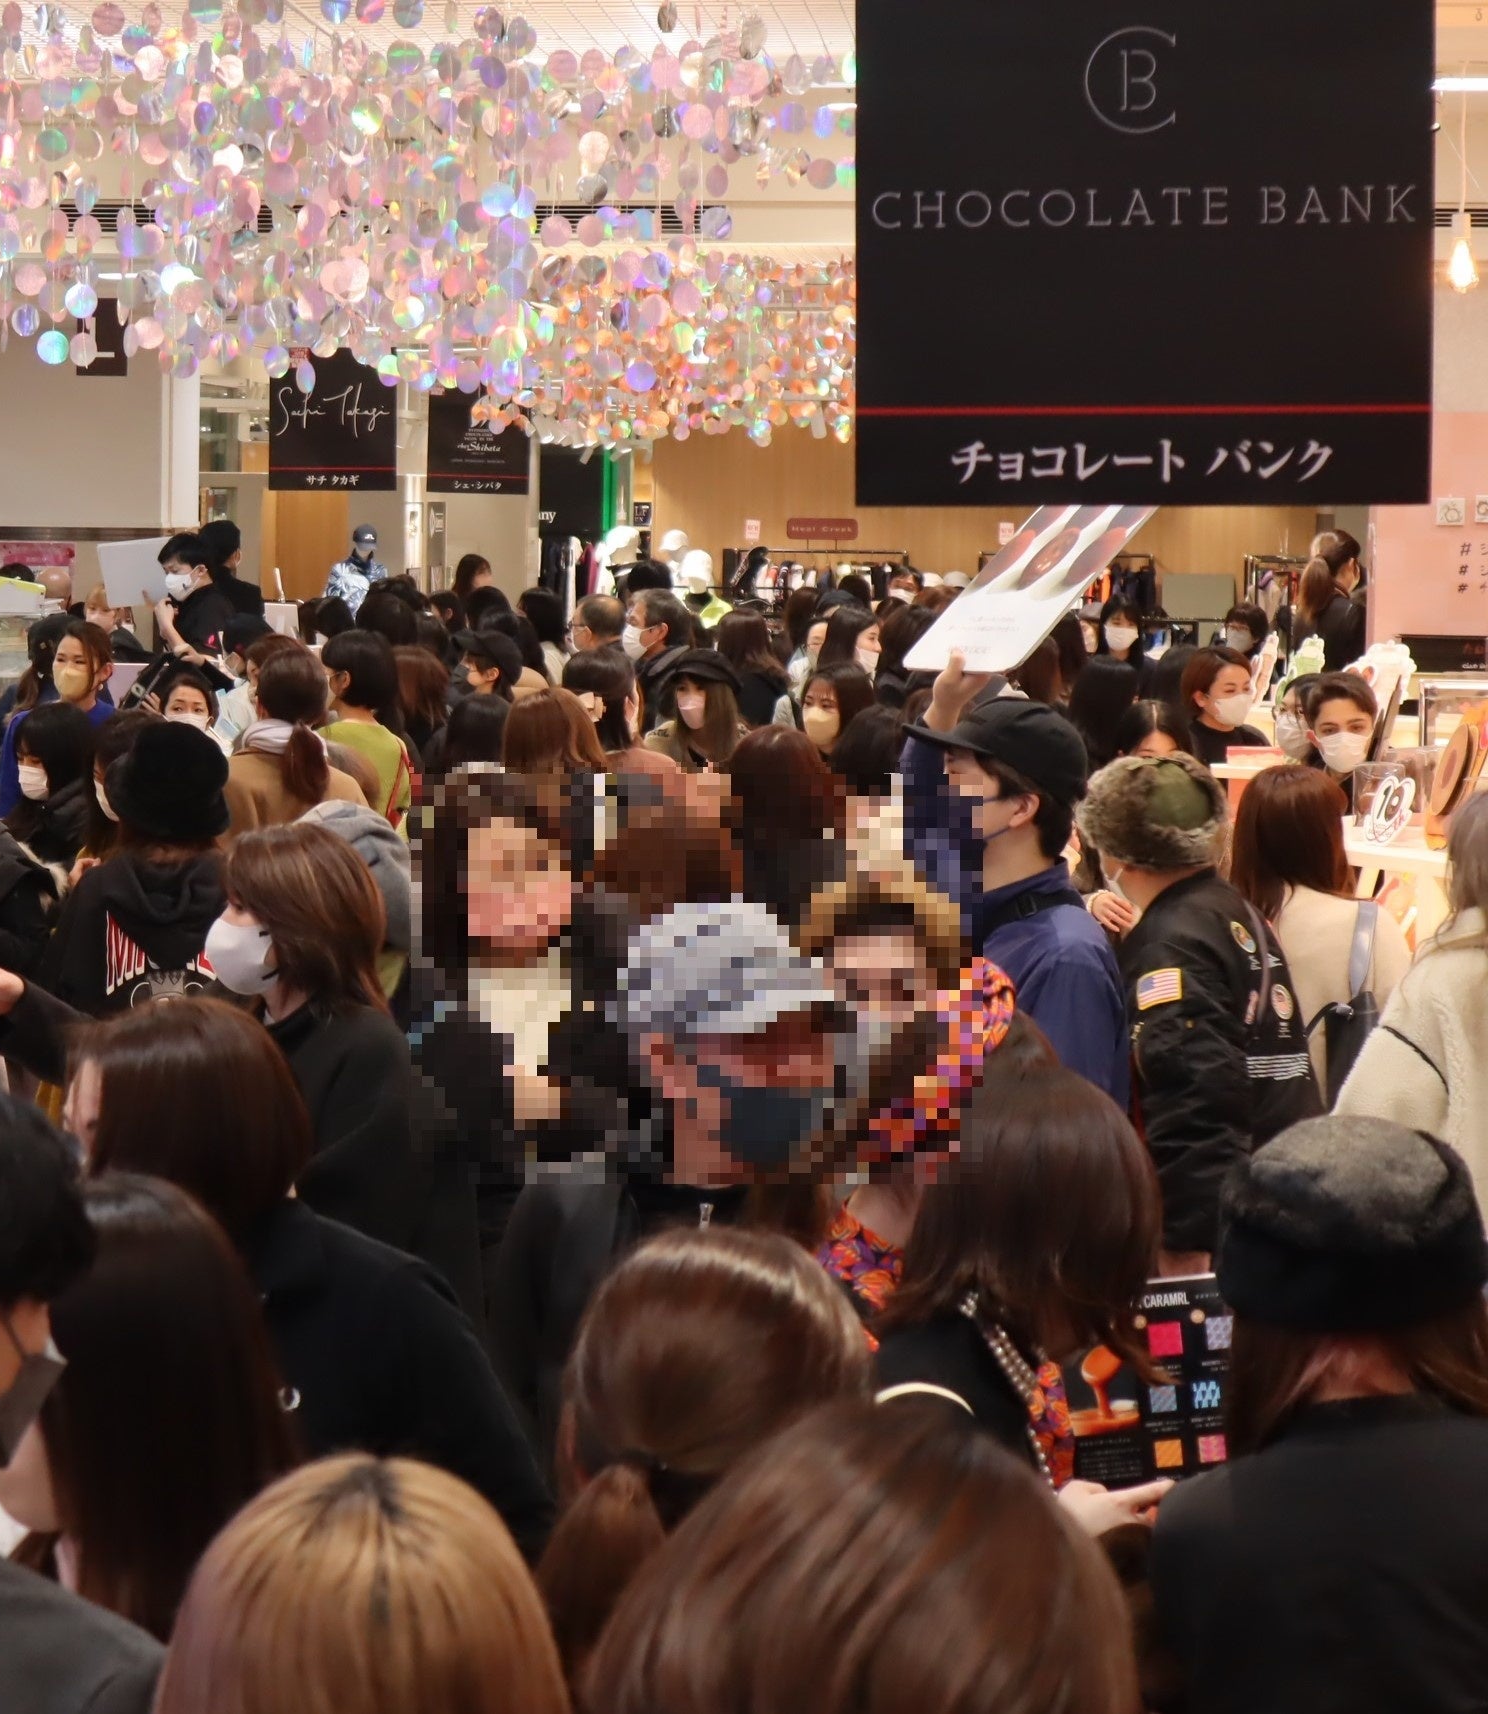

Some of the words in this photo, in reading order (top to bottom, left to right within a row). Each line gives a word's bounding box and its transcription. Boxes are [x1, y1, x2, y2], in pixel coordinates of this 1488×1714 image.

[872, 186, 1228, 229] CHOCOLATE
[1260, 184, 1416, 224] BANK
[323, 382, 390, 438] Takagi
[306, 475, 327, 486] サチ
[331, 475, 360, 486] タカギ
[951, 438, 1186, 484] チョコレート
[1205, 439, 1334, 483] バンク
